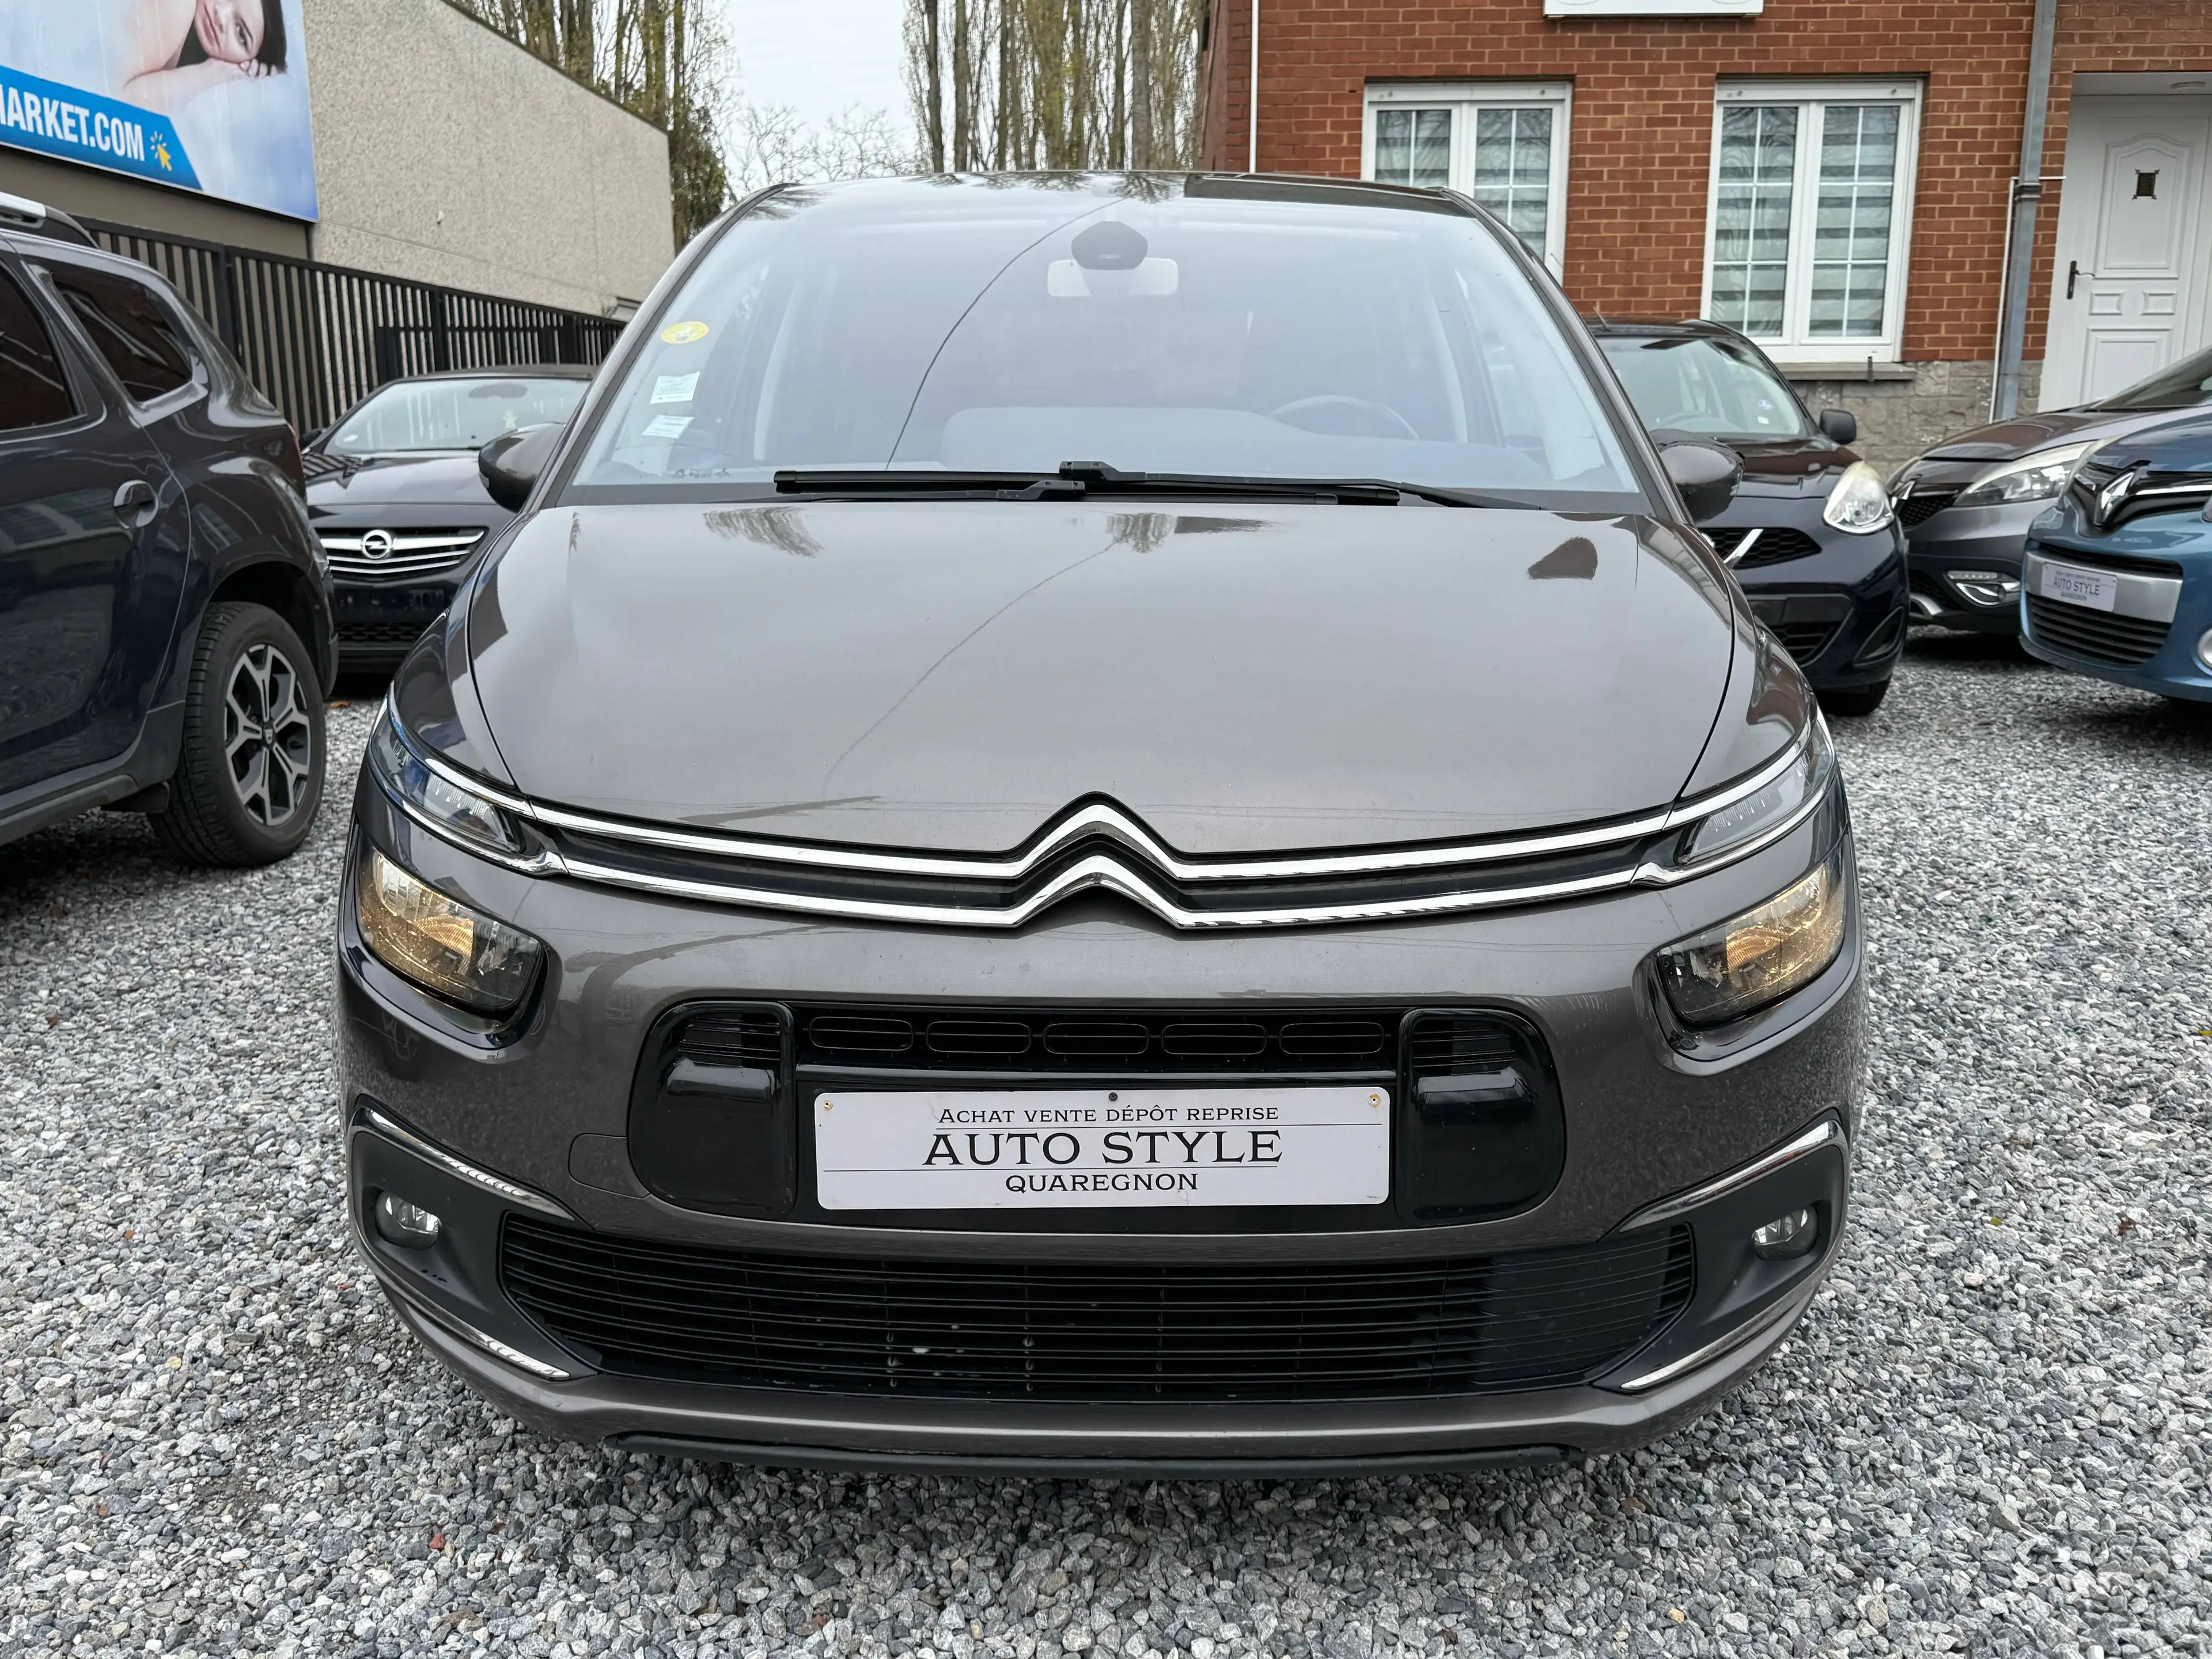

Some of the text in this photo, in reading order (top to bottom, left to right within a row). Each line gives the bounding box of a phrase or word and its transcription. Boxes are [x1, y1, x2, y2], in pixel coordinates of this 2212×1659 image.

[2054, 577, 2100, 596] AUTO STYLE
[938, 1104, 1279, 1123] ACHAT VENTE DÉPÔT REPRISE
[922, 1130, 1283, 1165] AUTO STYLE
[1006, 1173, 1198, 1194] QUAREGNON
